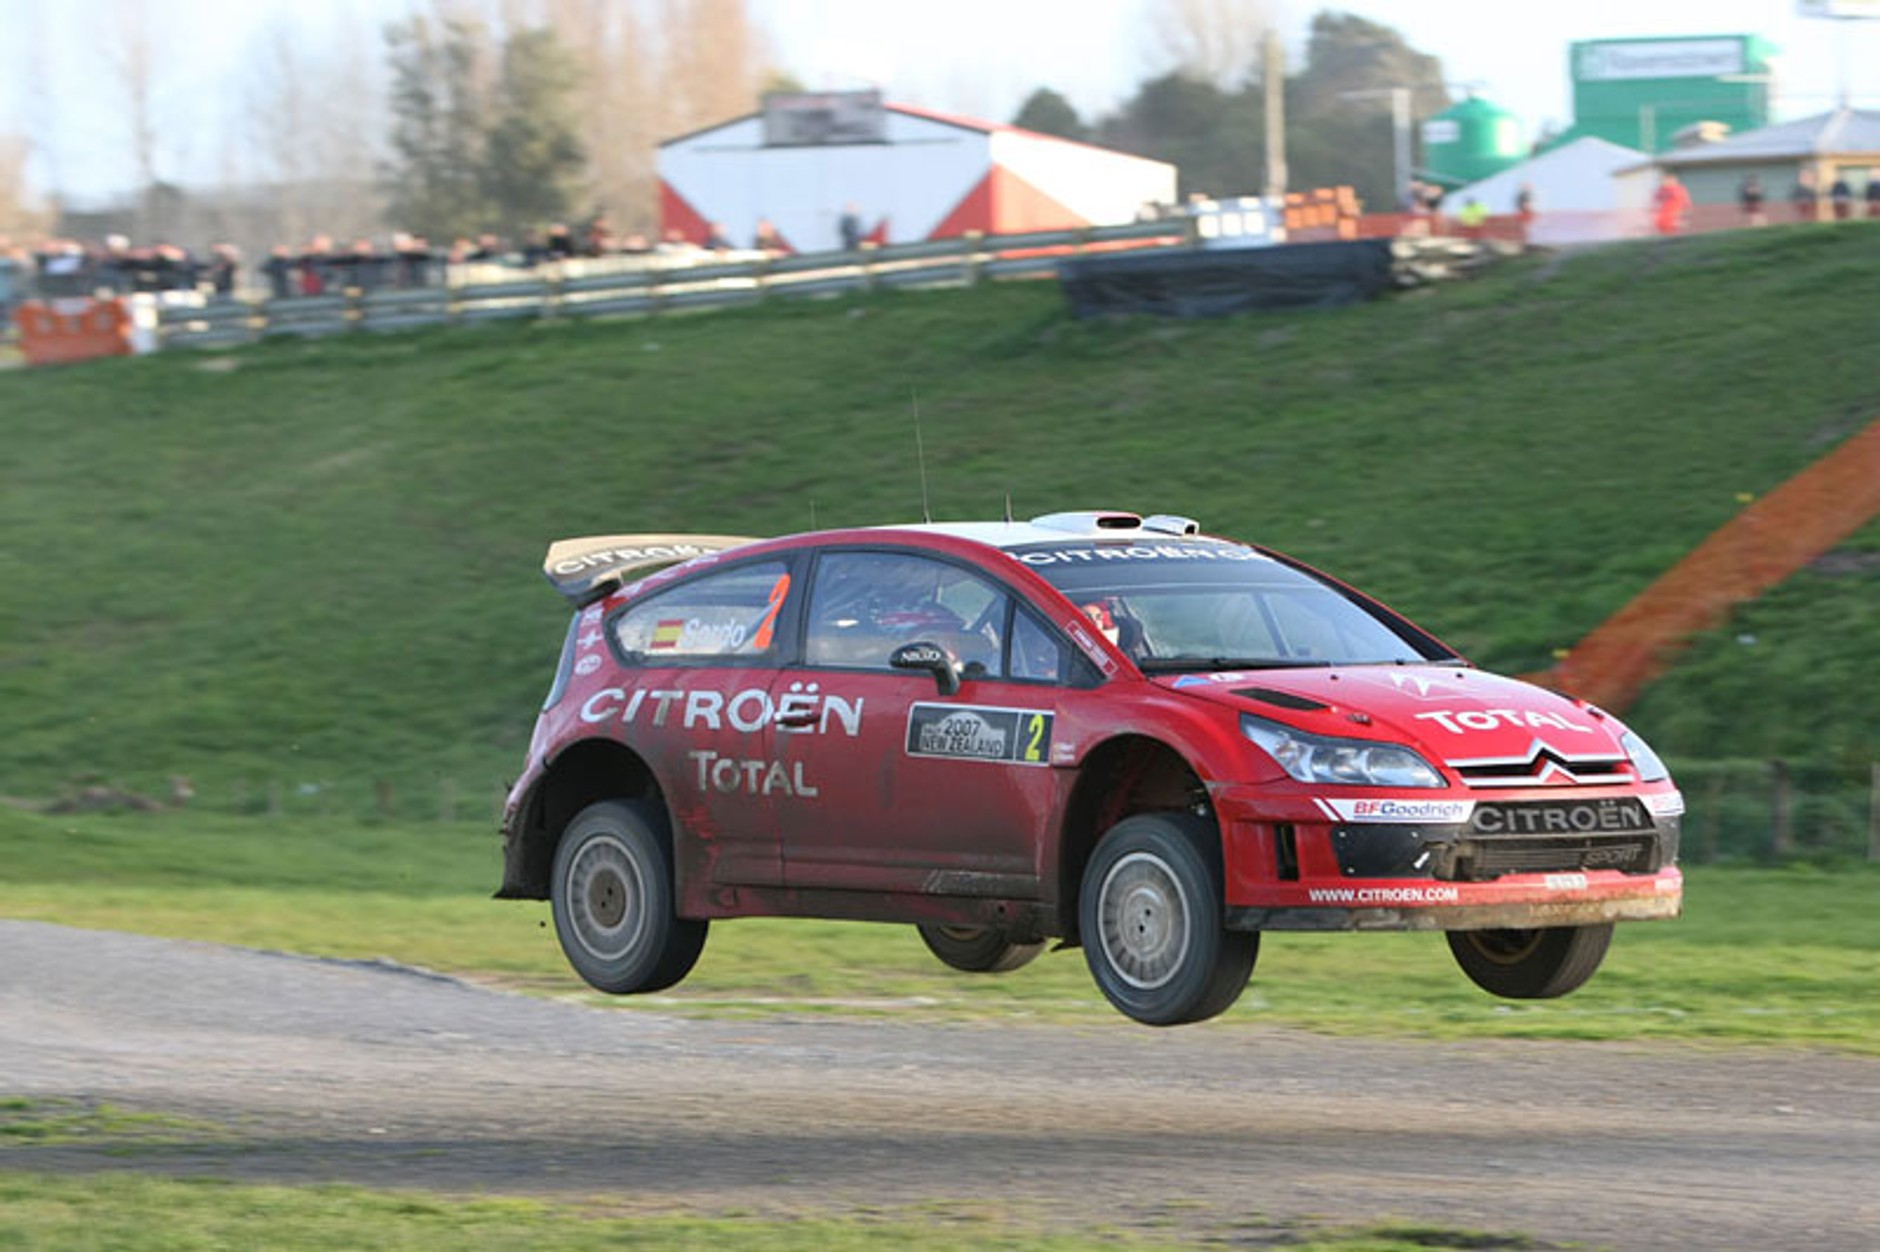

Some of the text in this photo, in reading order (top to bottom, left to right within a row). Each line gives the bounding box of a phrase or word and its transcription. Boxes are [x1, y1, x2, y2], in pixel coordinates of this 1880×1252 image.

[684, 617, 747, 648] Sordo
[580, 681, 865, 736] CITROËN
[1414, 709, 1594, 735] TOTAL
[944, 718, 981, 737] 2007
[1024, 714, 1045, 762] 2
[922, 735, 1003, 756] NEW ZEALAND
[689, 751, 818, 797] TOTAL
[1353, 800, 1463, 817] BFGoodrich
[1471, 800, 1643, 832] CITROËN
[1308, 887, 1458, 903] WWW.CITROEN.COM
